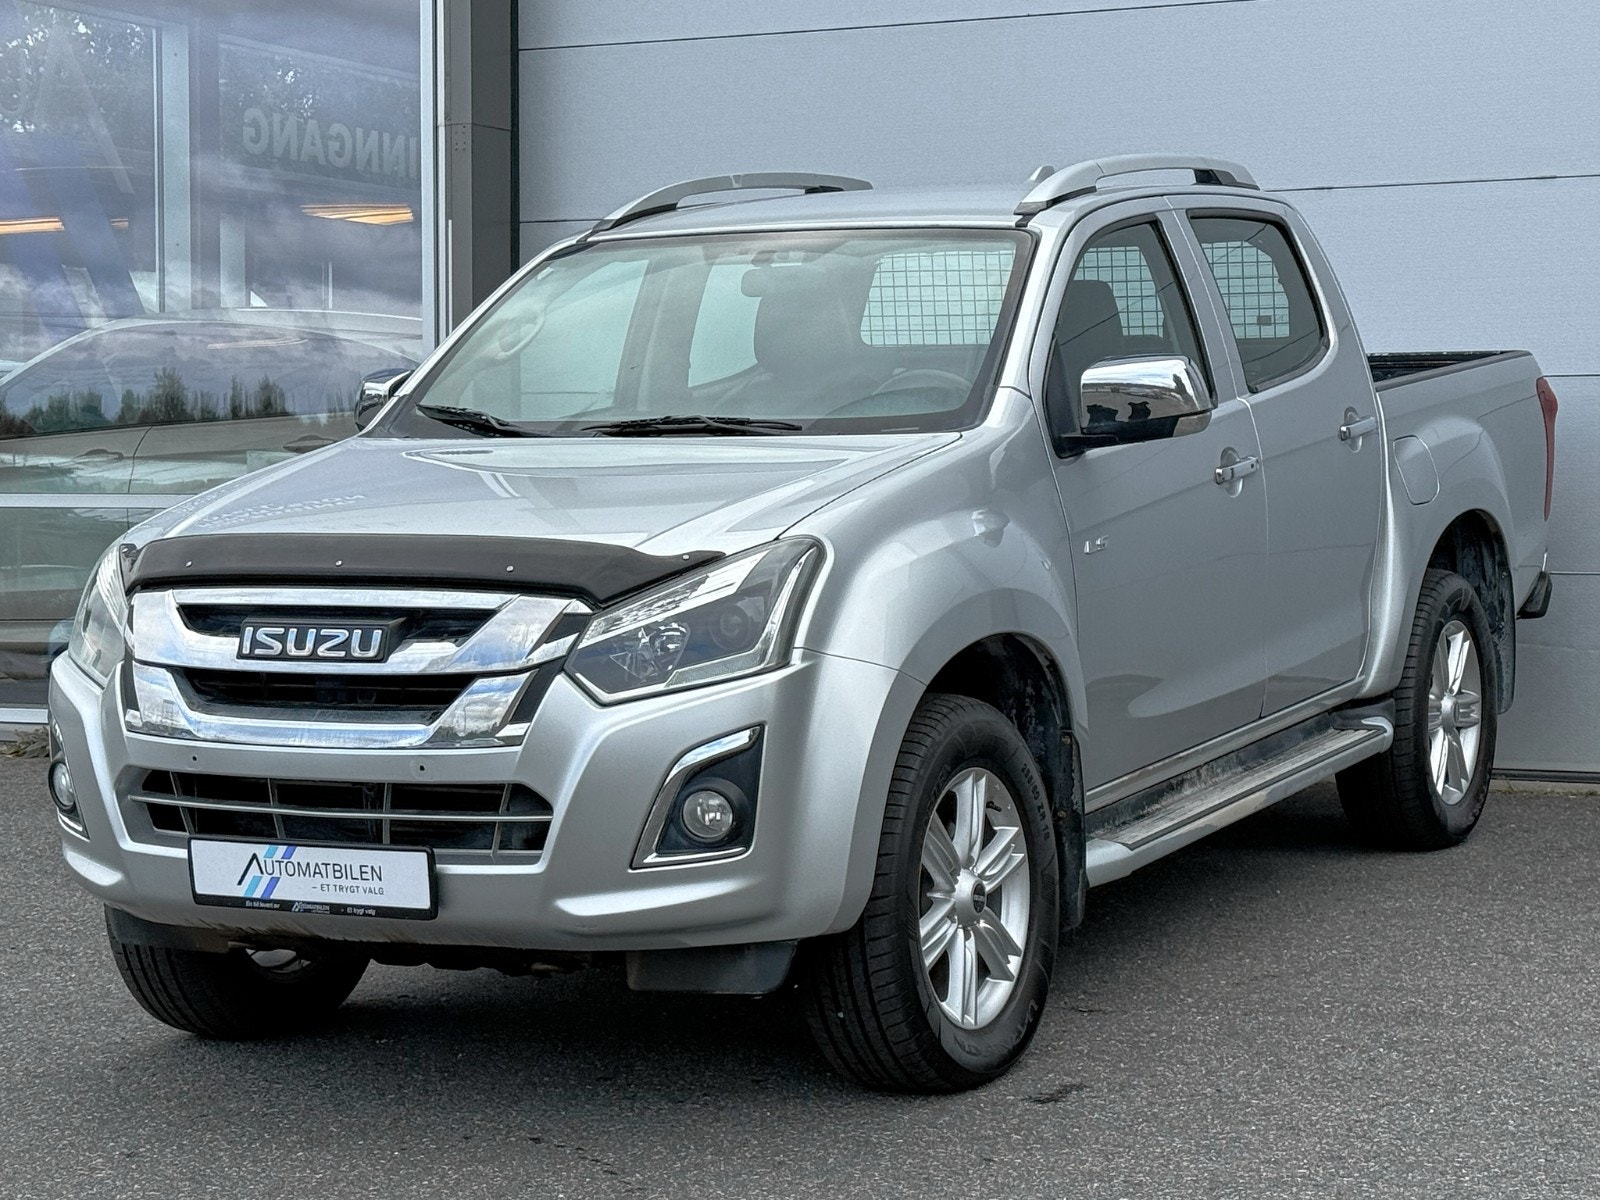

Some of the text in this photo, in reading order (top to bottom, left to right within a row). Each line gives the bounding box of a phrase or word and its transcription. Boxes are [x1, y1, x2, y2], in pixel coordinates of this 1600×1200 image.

[242, 626, 383, 658] ISUZU
[236, 852, 384, 887] AUTOMATBILEN
[320, 883, 331, 893] ET
[332, 884, 361, 895] TRYGT
[362, 885, 385, 896] VALG
